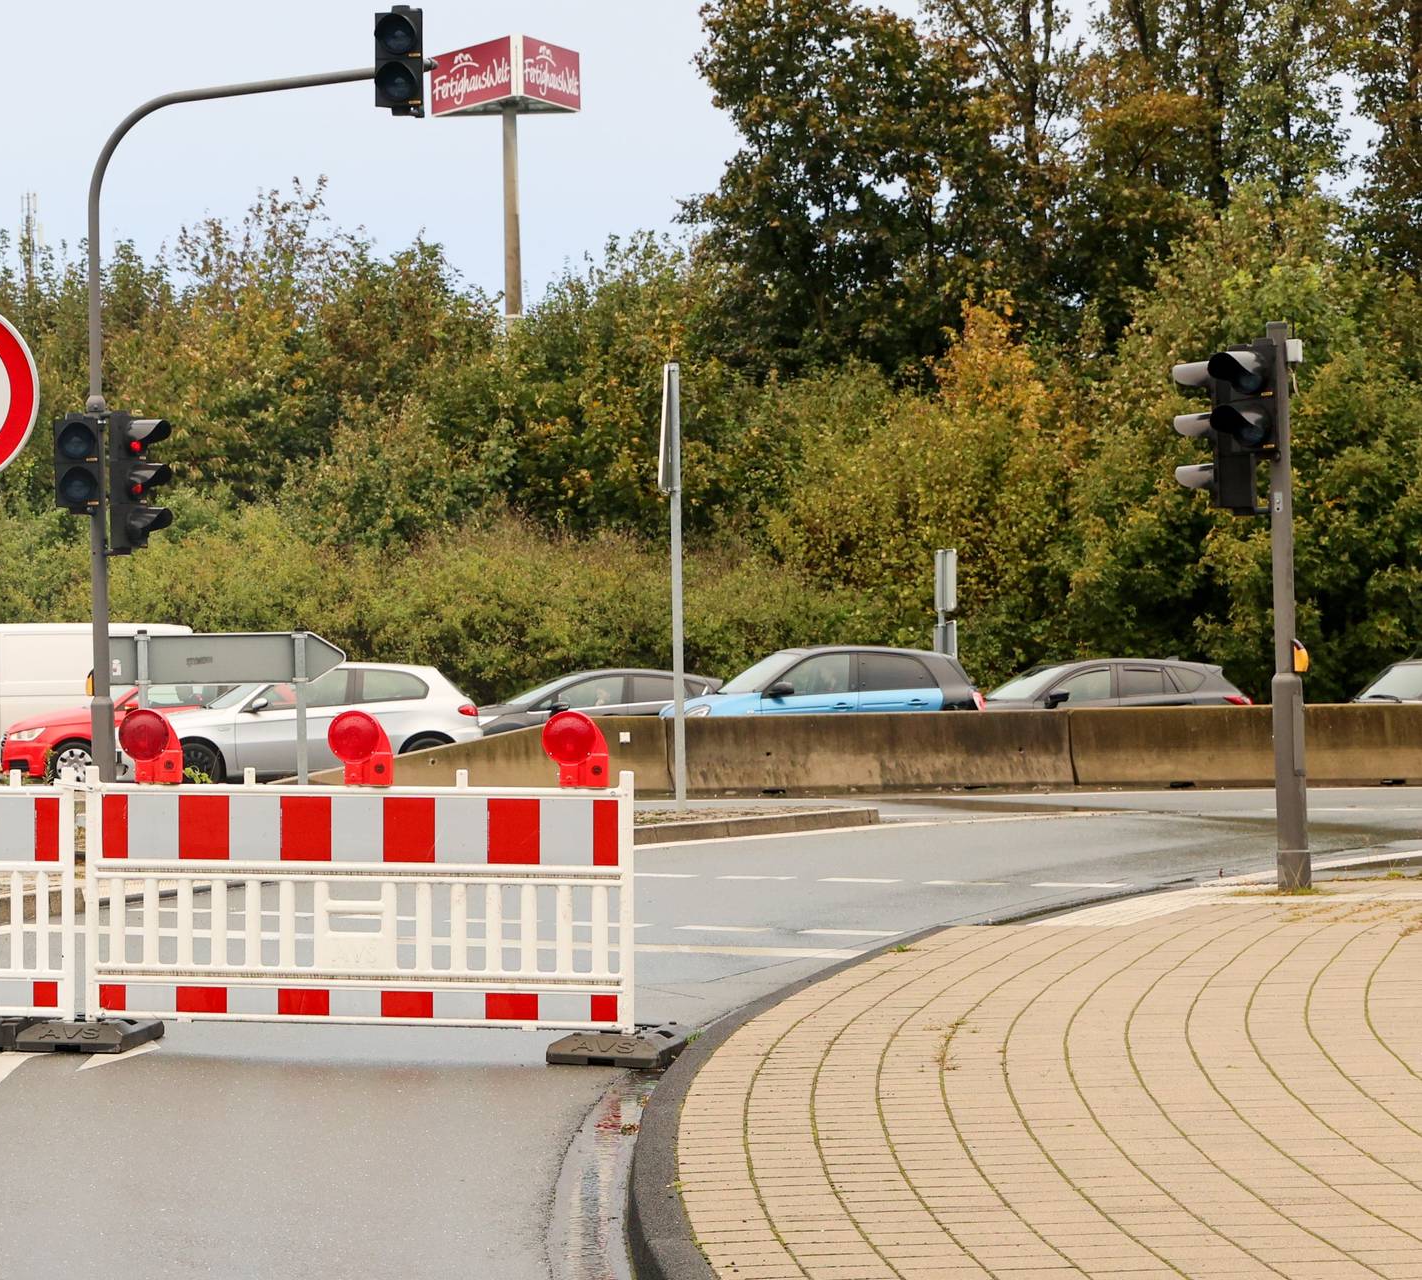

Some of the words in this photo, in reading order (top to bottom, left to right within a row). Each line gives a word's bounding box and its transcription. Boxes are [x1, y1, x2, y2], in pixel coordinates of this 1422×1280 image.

[433, 57, 510, 105] FertighausWelt
[524, 58, 579, 97] FertighausWelt
[38, 1027, 101, 1040] AVS
[571, 1038, 636, 1054] AVS
